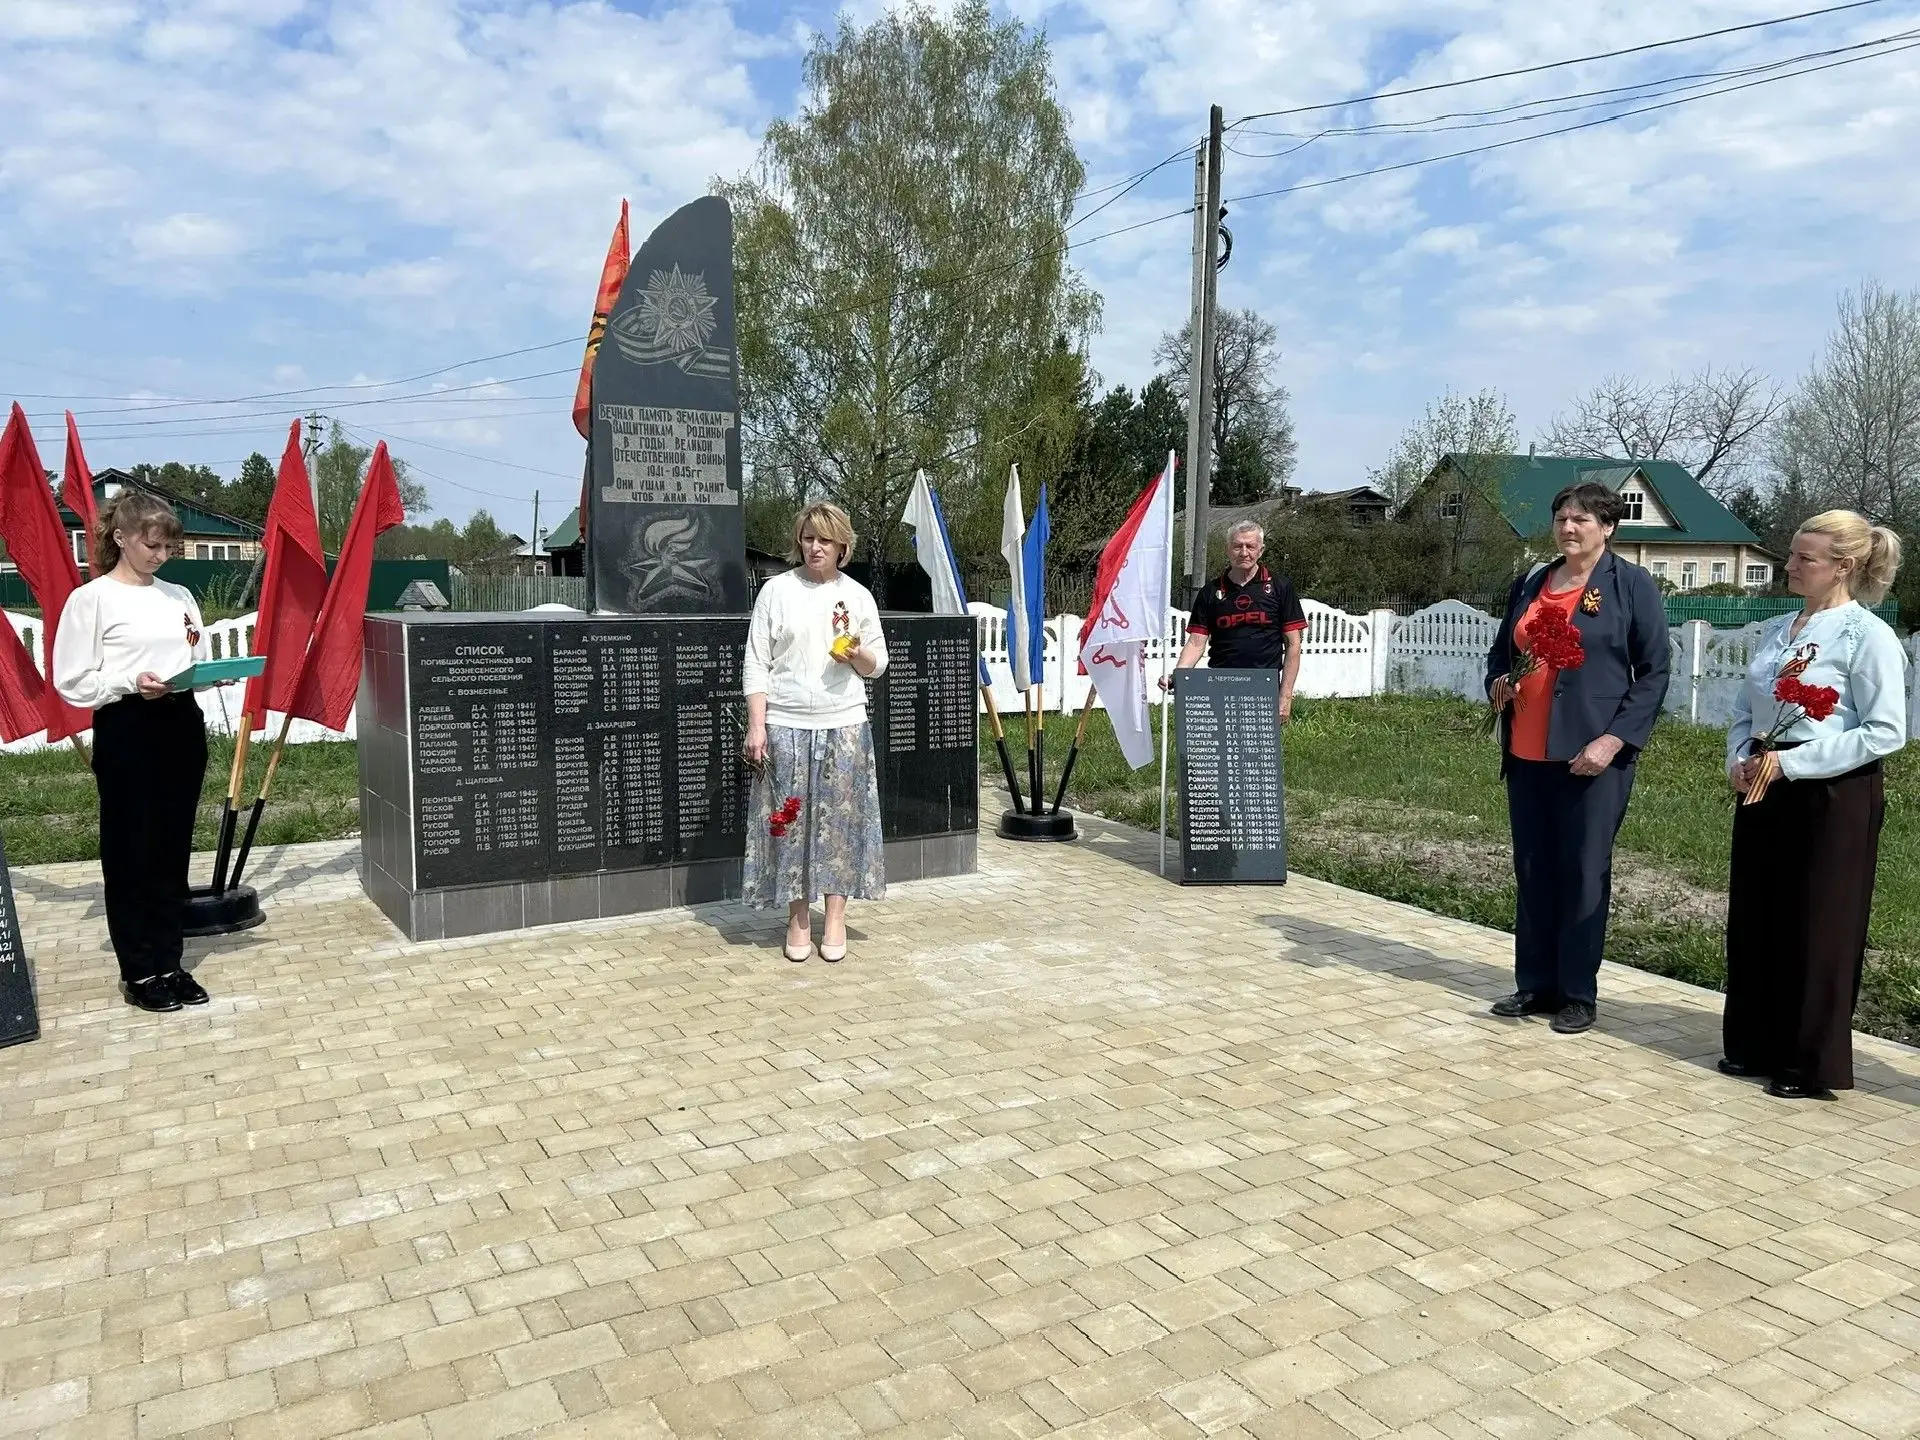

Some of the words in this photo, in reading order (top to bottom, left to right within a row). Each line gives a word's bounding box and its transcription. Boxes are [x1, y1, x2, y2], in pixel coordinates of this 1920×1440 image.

[600, 404, 633, 420] ВЕЧНАЯ
[639, 409, 672, 421] ПАМЯТЬ
[614, 421, 673, 436] ЗАЩИТНИКАМ
[687, 425, 724, 438] РОДИНЫ
[624, 437, 629, 448] В
[640, 437, 665, 450] ГОДЫ
[617, 478, 633, 489] ОНИ
[640, 480, 664, 490] УШЛИ
[677, 482, 682, 491] В
[694, 482, 724, 492] ГРАНИТ
[632, 492, 653, 501] ЧТОБ
[663, 493, 686, 502] ЖИЛИ
[695, 494, 710, 503] МЫ
[1217, 612, 1272, 628] OPEL
[455, 646, 504, 655] СПИСОК
[419, 722, 471, 731] ДОБРОХОТОВ
[420, 749, 456, 757] ПОСУДИН
[465, 777, 503, 785] ЩАПОВКА
[423, 822, 448, 830] РУСОВ
[423, 830, 460, 838] ТОПОРОВ
[423, 838, 460, 846] ТОПОРОВ
[424, 848, 449, 856] РУСОВ
